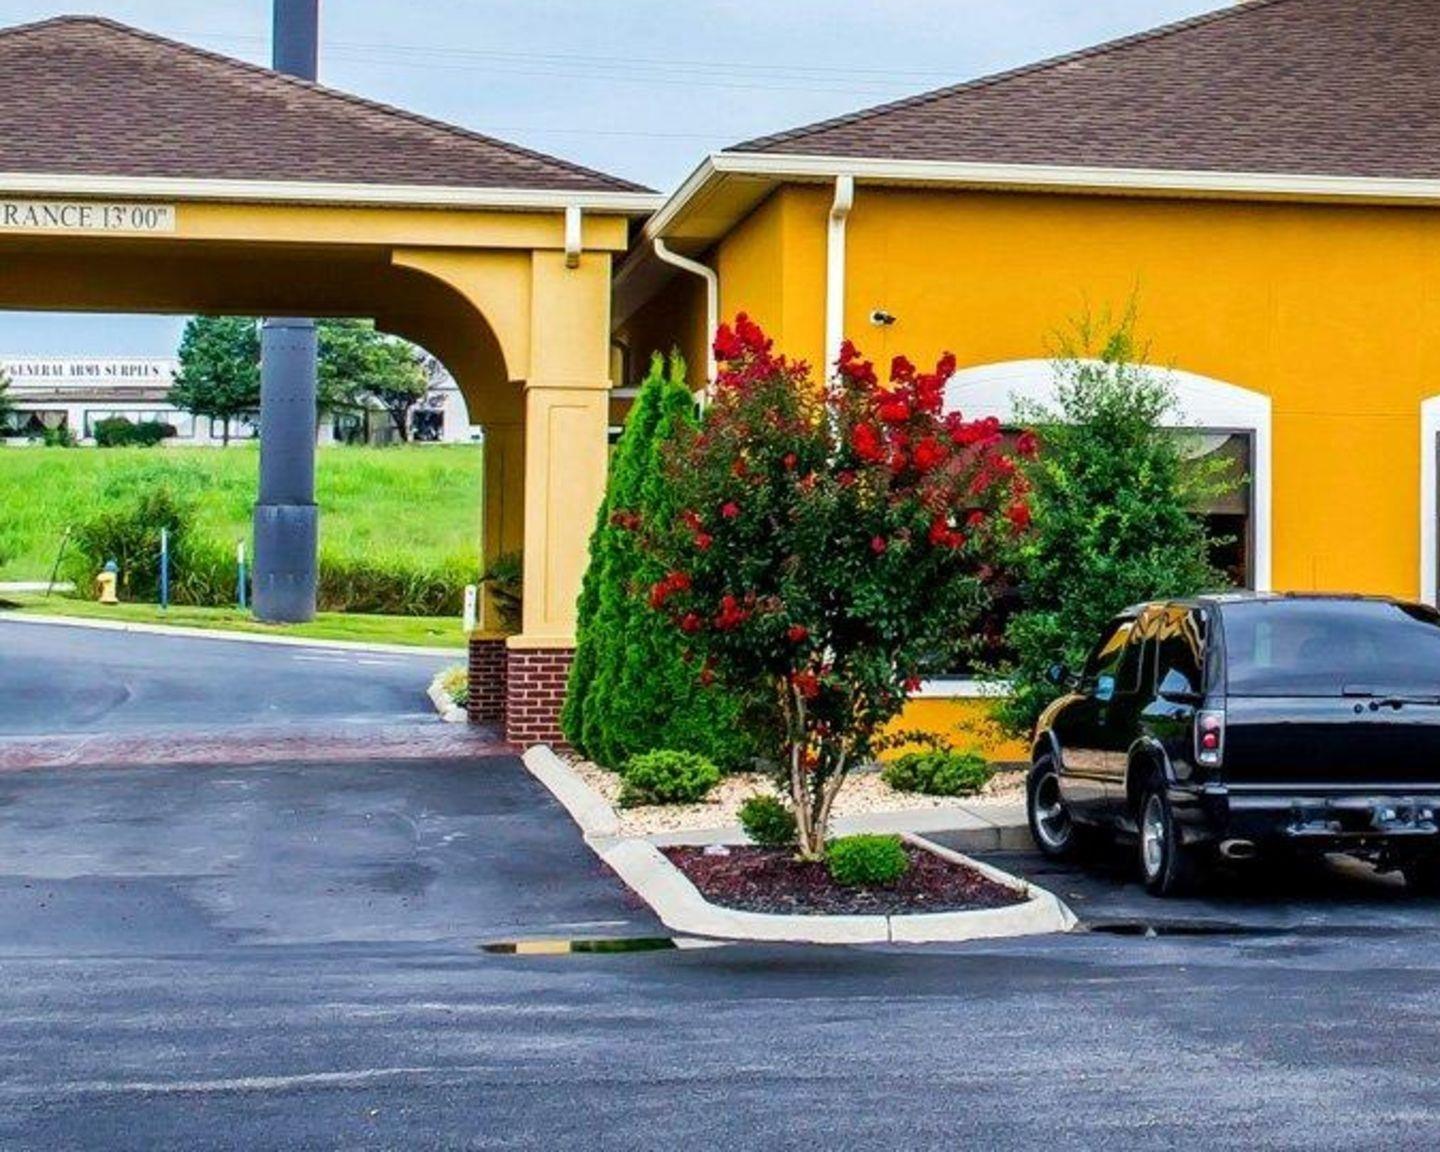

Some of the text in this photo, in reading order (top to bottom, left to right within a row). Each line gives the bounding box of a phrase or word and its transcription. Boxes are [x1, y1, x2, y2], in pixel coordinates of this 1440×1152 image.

[4, 204, 92, 228] RANCE
[10, 364, 160, 377] GENERAL ARMY SURPLUS
